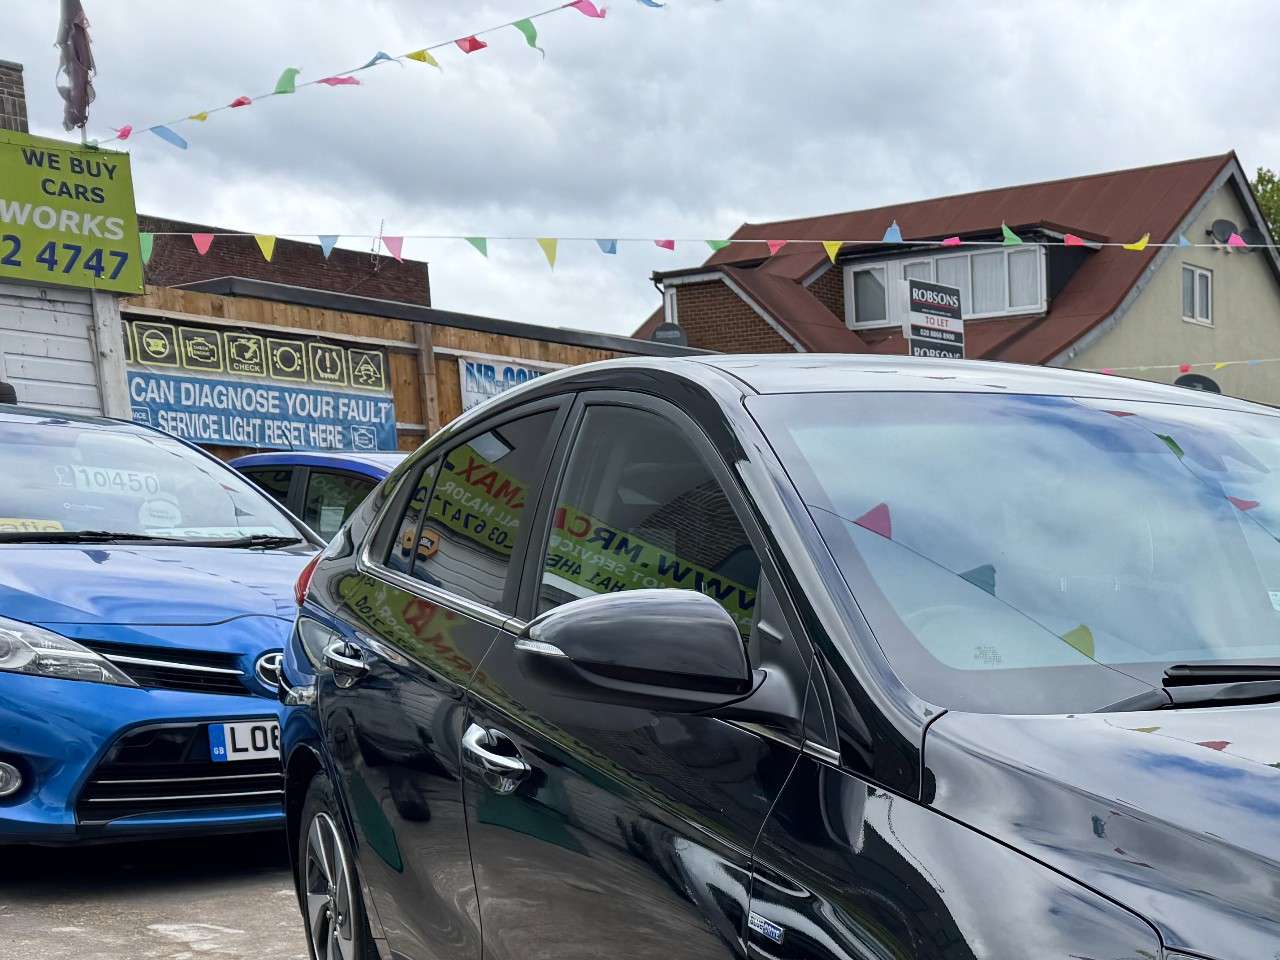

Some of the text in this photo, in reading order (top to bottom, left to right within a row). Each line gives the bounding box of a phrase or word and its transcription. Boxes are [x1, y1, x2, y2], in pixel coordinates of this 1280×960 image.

[21, 148, 118, 181] WE BUY
[41, 177, 105, 204] CARS
[0, 199, 125, 241] WORKS
[35, 240, 129, 281] 4747
[912, 288, 959, 307] ROBSONS
[926, 315, 949, 328] TO LET
[233, 362, 261, 372] CHECK
[131, 377, 391, 423] CAN DIAGNOSE YOUR FAULT
[158, 410, 219, 439] SERVICE
[221, 415, 262, 443] LIGHT
[264, 419, 306, 445] RESET
[309, 424, 344, 448] HERE
[213, 746, 225, 755] GB
